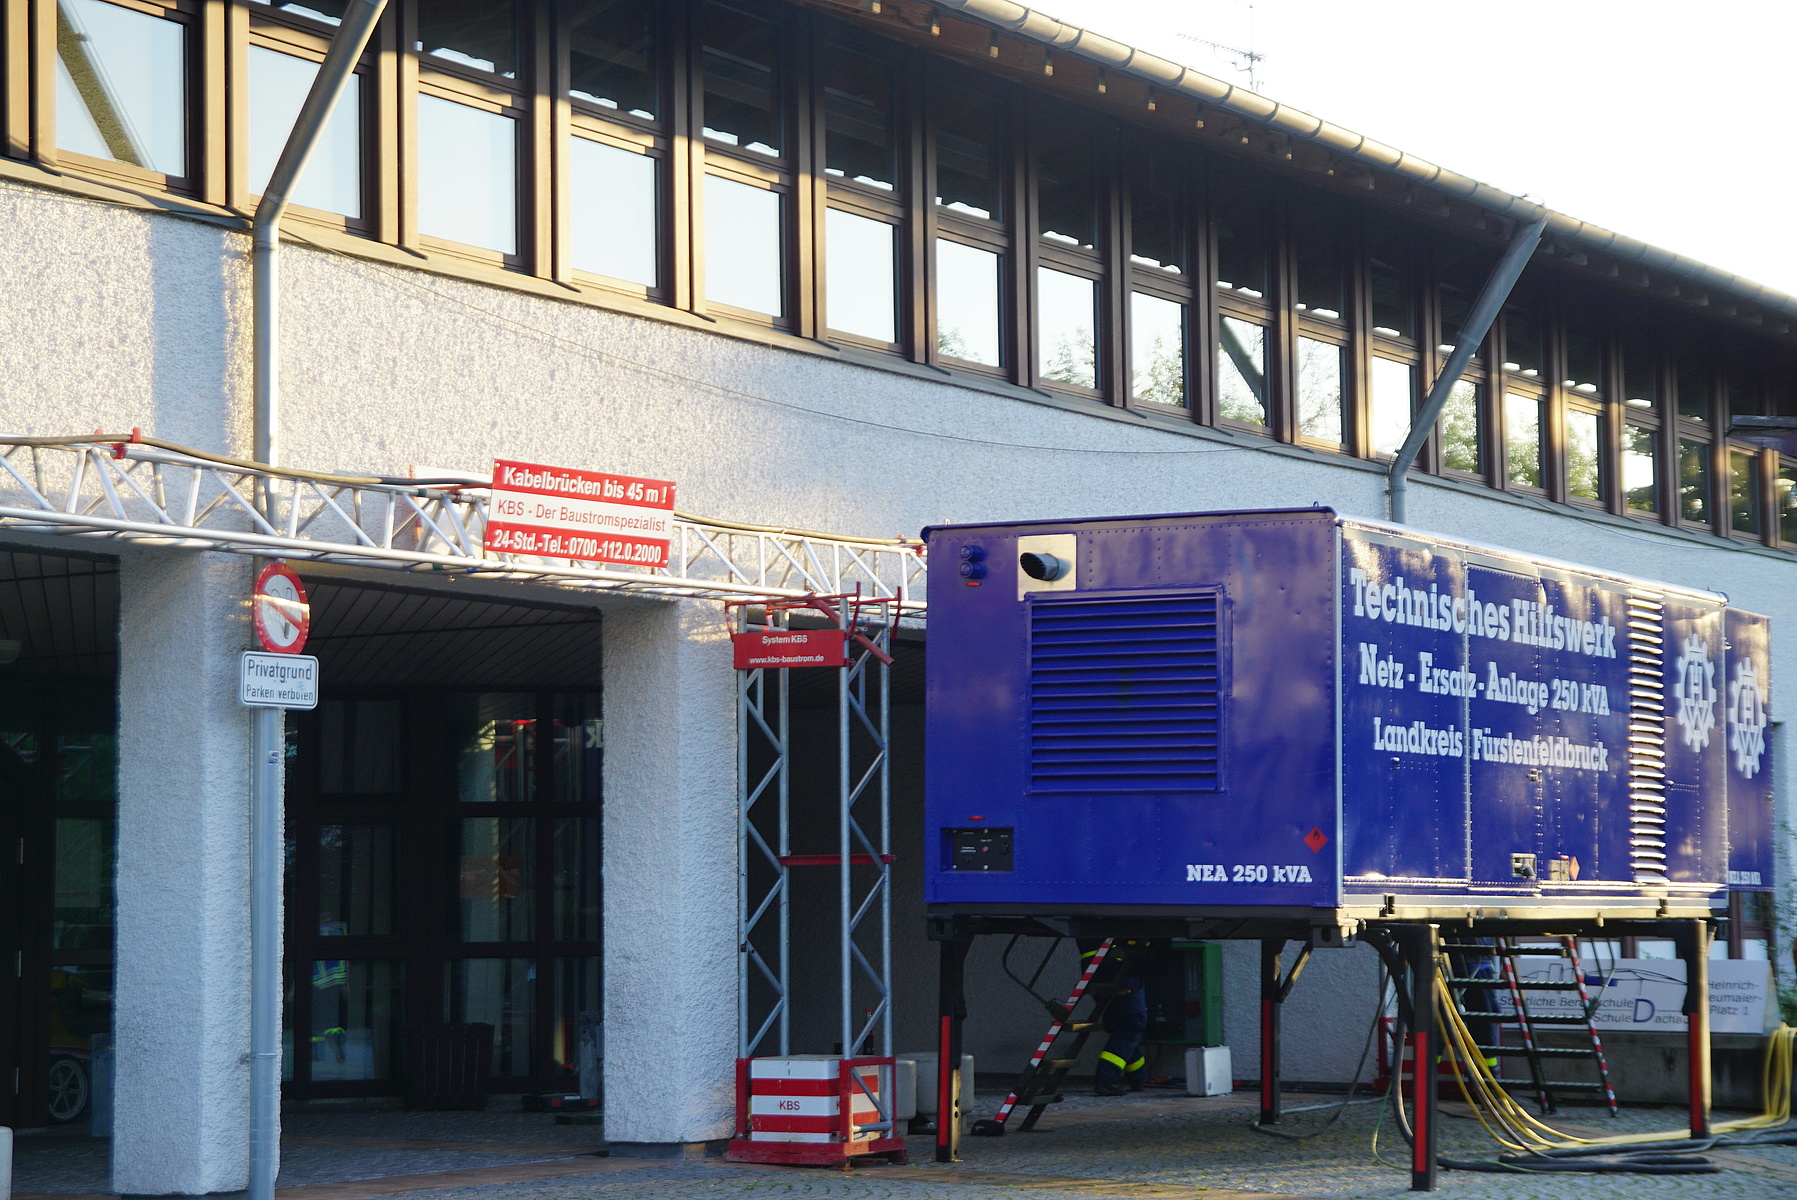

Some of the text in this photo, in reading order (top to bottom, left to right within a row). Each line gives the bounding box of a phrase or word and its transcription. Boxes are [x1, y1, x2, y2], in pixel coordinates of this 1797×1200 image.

[503, 466, 601, 496] Kabelbrücken
[604, 478, 625, 498] bis
[627, 482, 644, 501] 45
[497, 499, 524, 516] KBS
[536, 504, 557, 520] Der
[560, 506, 666, 532] Baustromspezialist
[1350, 567, 1616, 658] Technisches Hilfswerk
[762, 635, 808, 646] System KBS
[749, 654, 824, 664] www.kbs-baustrom.de
[248, 659, 312, 683] Privatgrund
[1359, 642, 1404, 689] Netz
[1552, 678, 1579, 712] 250
[1582, 682, 1611, 716] kVA
[246, 684, 275, 699] Parken
[1373, 717, 1608, 771] Landkreis Fürstenfeldbruck
[1186, 864, 1313, 883] NEA 250 kVA
[1708, 993, 1763, 1003] eumaier-
[779, 1100, 800, 1110] KBS
